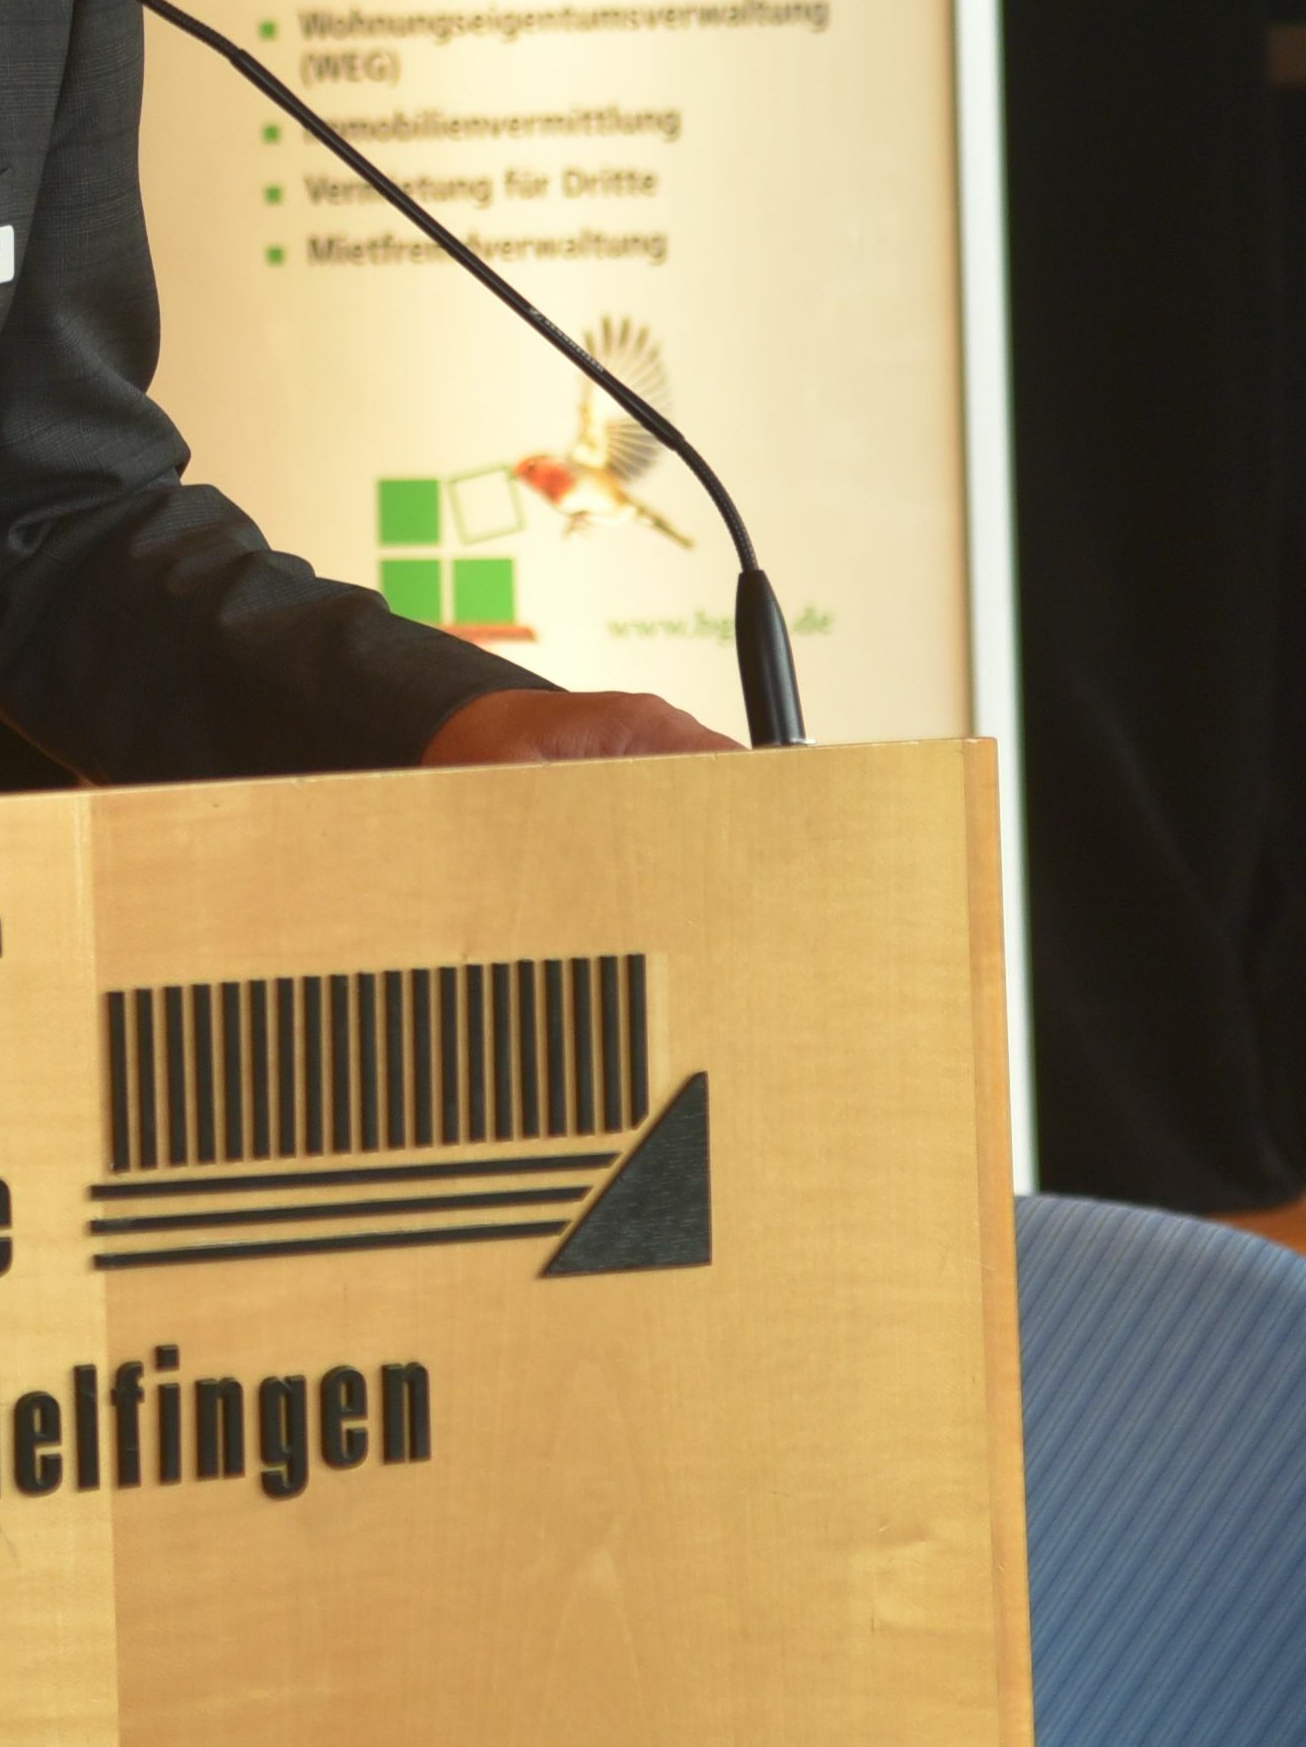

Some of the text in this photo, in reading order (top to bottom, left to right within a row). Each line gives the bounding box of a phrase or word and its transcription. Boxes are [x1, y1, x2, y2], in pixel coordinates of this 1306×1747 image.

[300, 49, 402, 90] (WEG)
[303, 167, 659, 210] Vermetung für Dritte
